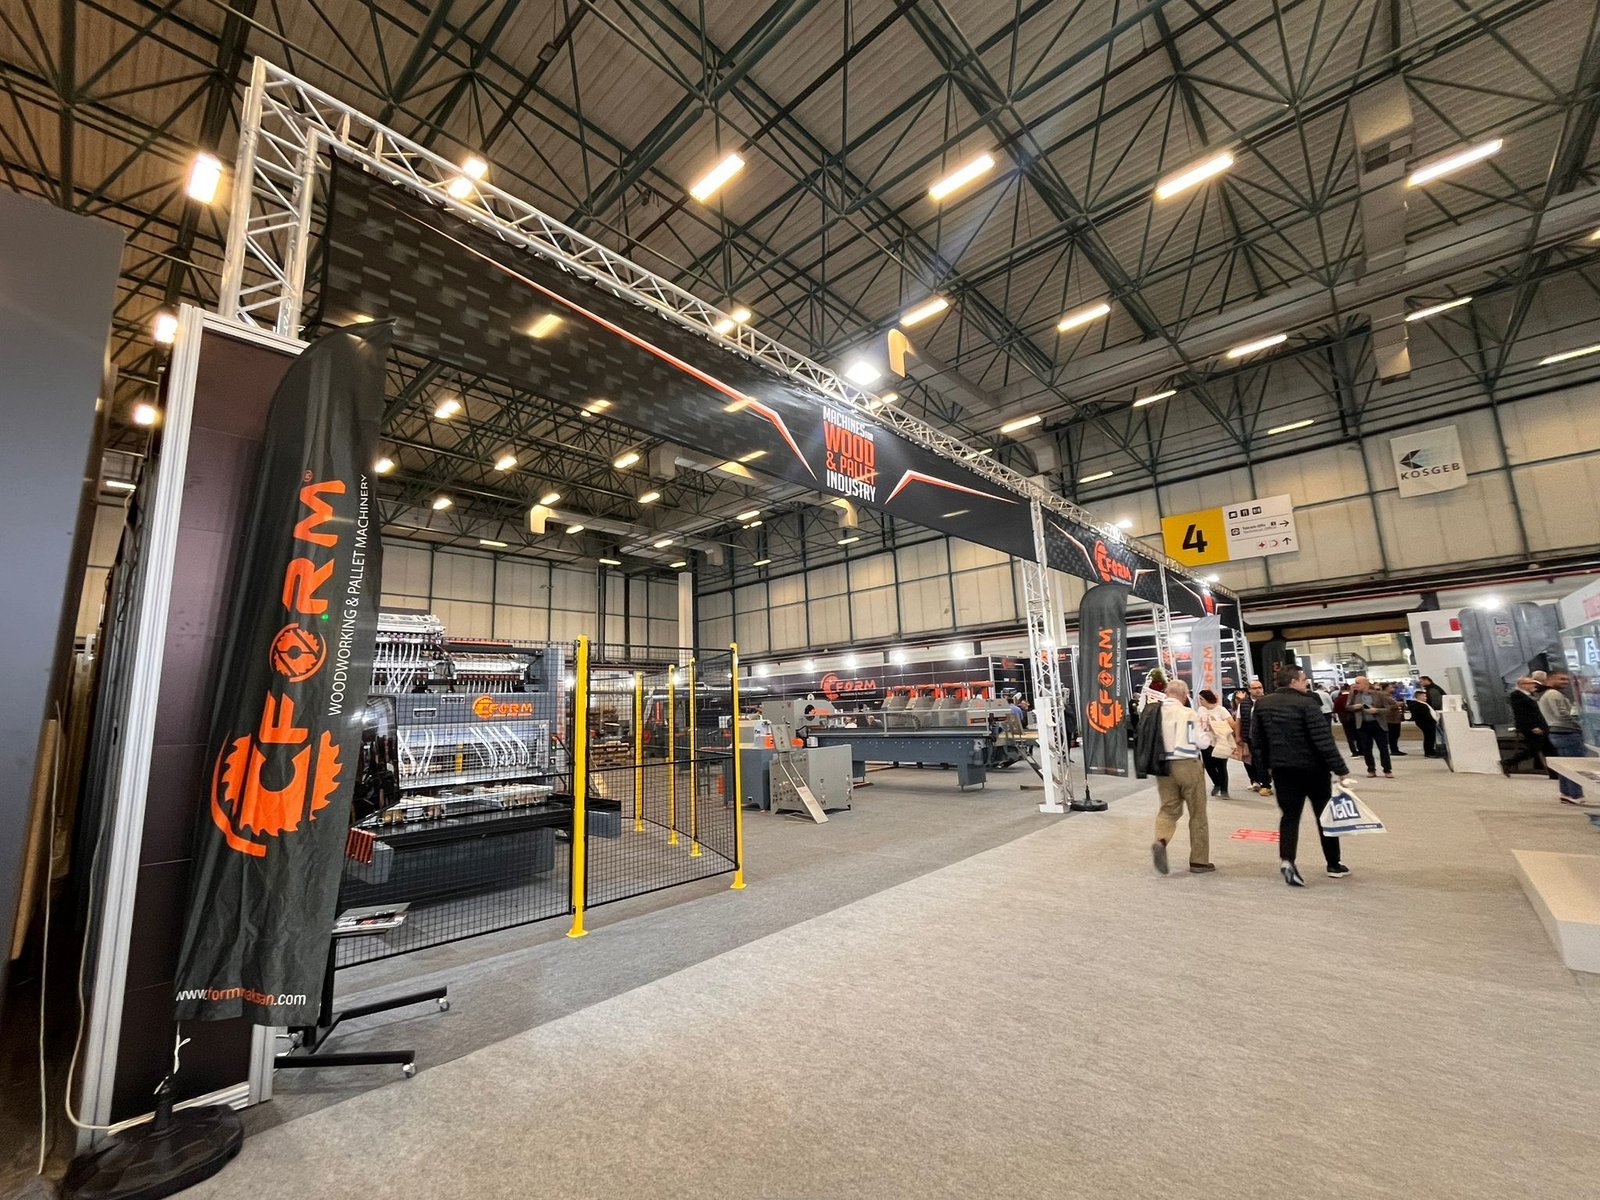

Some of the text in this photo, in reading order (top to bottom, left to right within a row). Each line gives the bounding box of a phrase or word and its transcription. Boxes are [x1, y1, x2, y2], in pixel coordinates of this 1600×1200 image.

[823, 405, 866, 436] MACHINES
[823, 421, 875, 467] WOOD
[826, 451, 876, 485] & PALLET
[1400, 462, 1460, 480] KOSGEB
[826, 469, 876, 503] INDUSTRY
[1182, 524, 1208, 553] 4
[327, 473, 370, 717] WOODWORKING & PALLET MACHINERY
